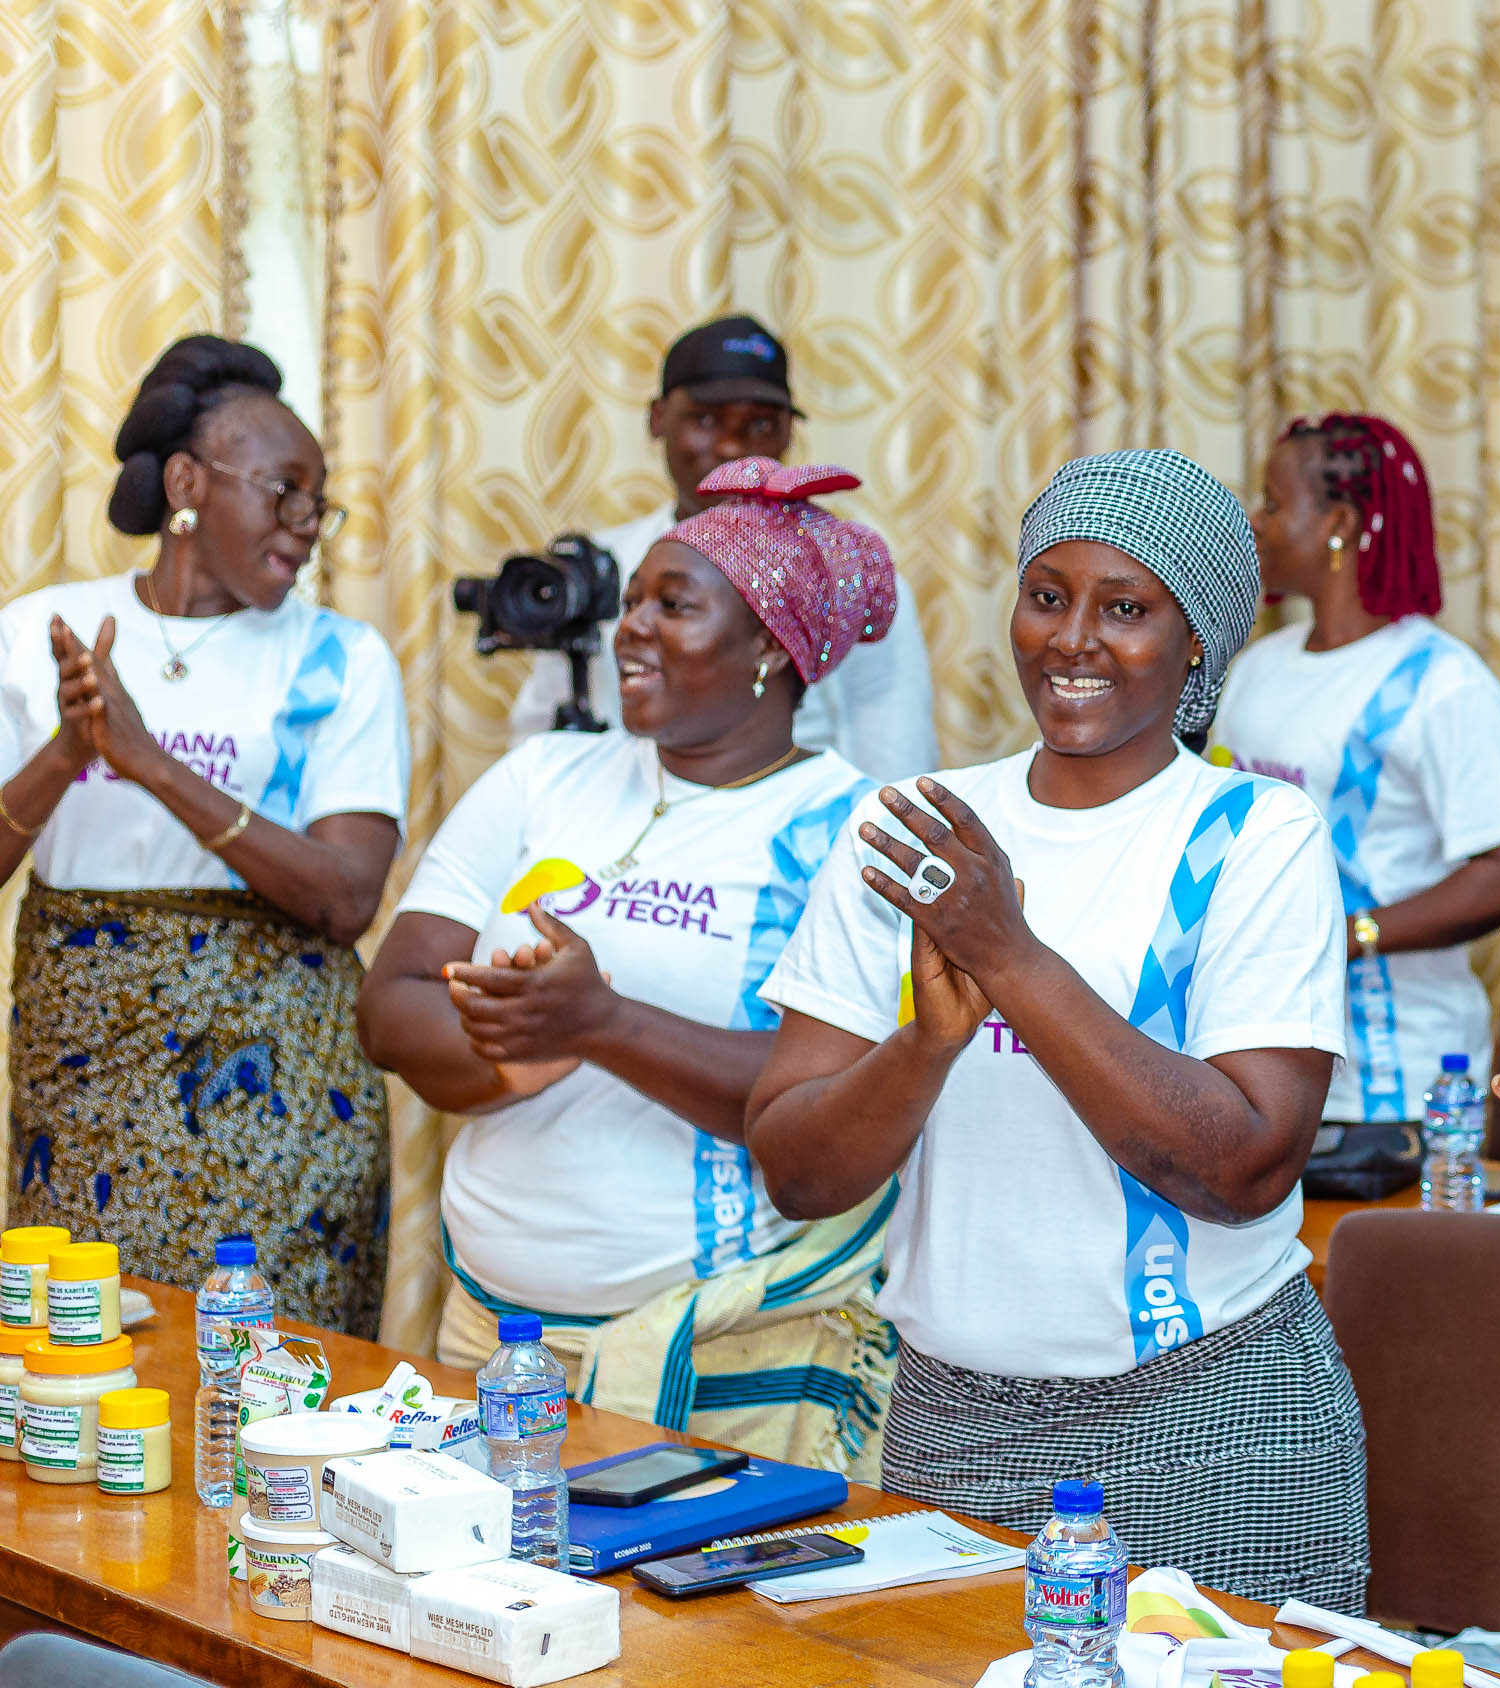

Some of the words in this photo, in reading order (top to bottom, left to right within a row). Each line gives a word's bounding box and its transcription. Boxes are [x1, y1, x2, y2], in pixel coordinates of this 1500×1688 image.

[610, 878, 718, 911] NANA
[604, 897, 733, 941] TECH_
[1138, 1243, 1190, 1355] sion
[1040, 1583, 1091, 1607] Voltic
[341, 1612, 356, 1623] MFG
[357, 1617, 375, 1628] MESH
[428, 1611, 444, 1624] WIRE
[445, 1616, 464, 1629] MESH
[465, 1622, 480, 1634] MFG
[481, 1627, 493, 1637] LTD
